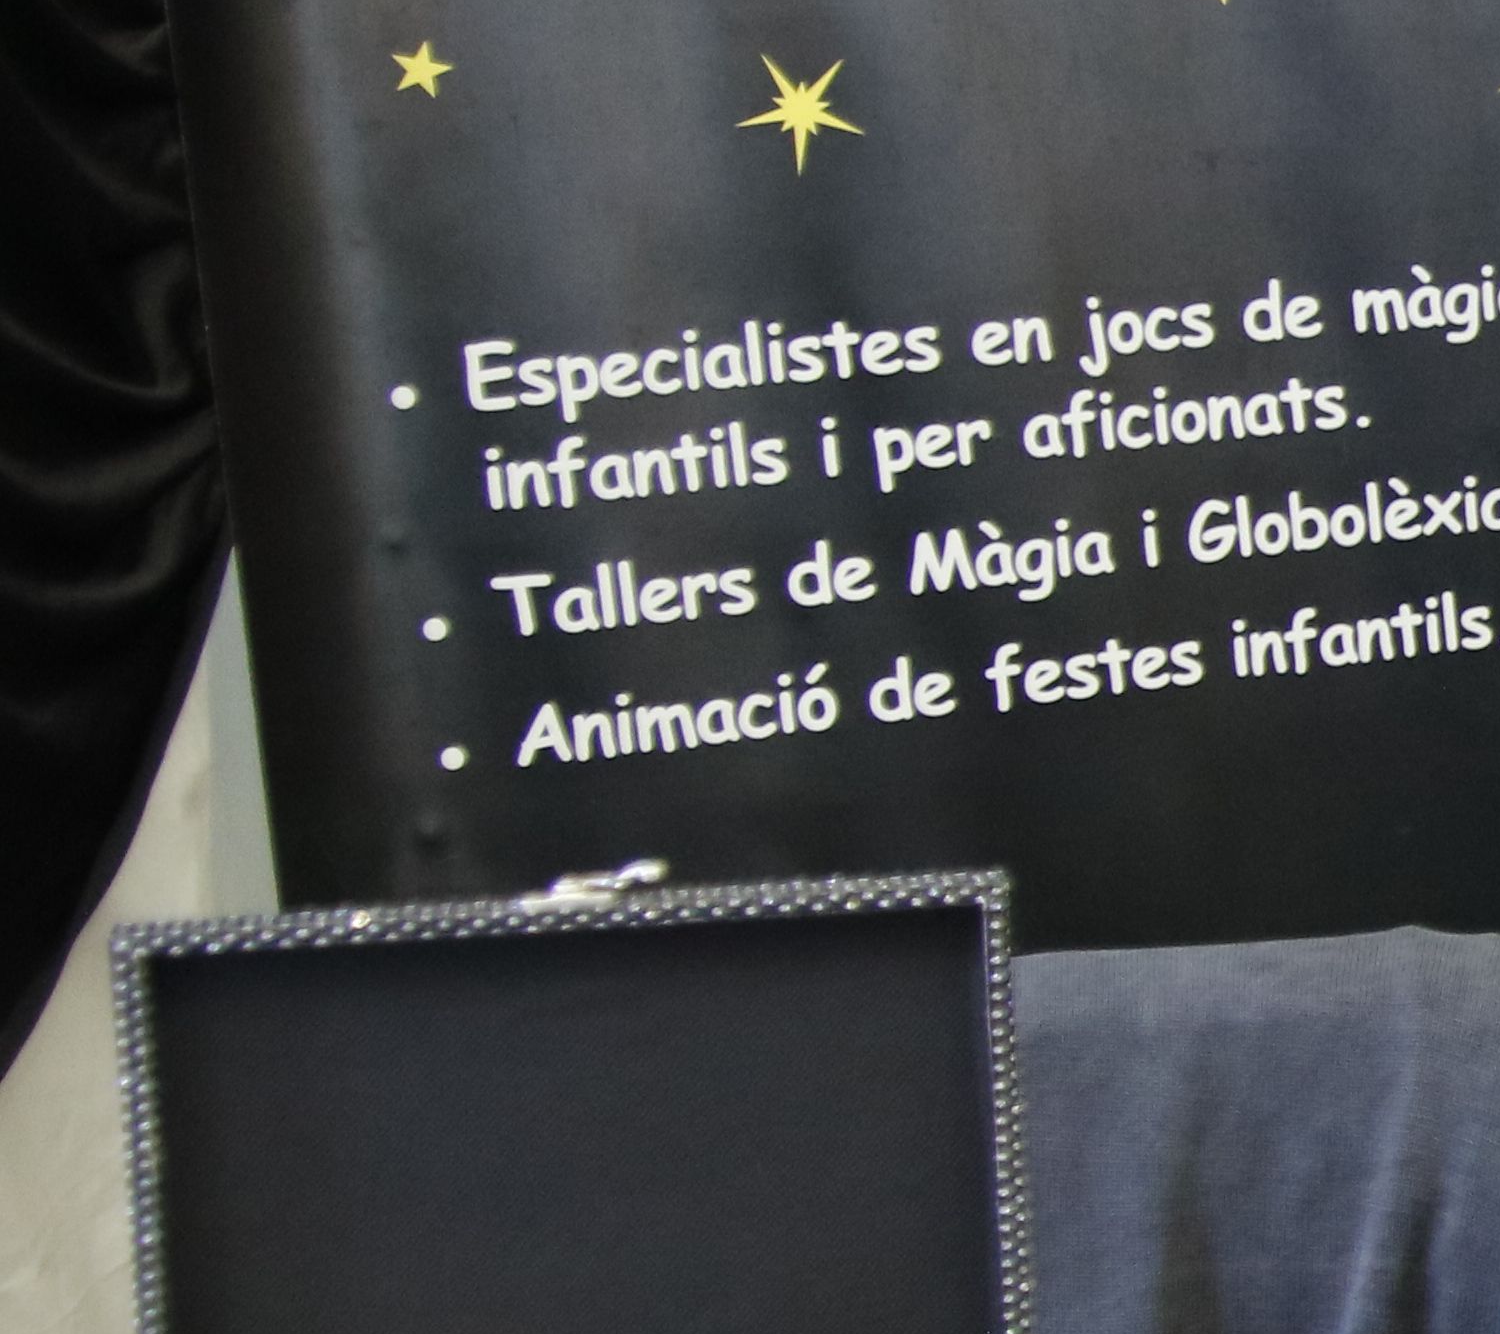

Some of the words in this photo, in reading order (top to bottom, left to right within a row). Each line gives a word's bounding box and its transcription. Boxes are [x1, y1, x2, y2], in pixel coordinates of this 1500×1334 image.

[464, 320, 941, 421] Especialistes
[972, 317, 1053, 365] en
[1079, 297, 1214, 376] jocs
[1243, 278, 1323, 341] de
[485, 421, 789, 509] infantils
[821, 417, 840, 477] i
[873, 420, 992, 493] per
[1024, 378, 1370, 458] aficionats.
[490, 560, 757, 636] Tallers
[788, 540, 876, 606] de
[910, 519, 1115, 601] Màgia
[1142, 509, 1159, 567] i
[518, 663, 838, 766] Animació
[869, 656, 956, 721] de
[985, 639, 1203, 712] festes
